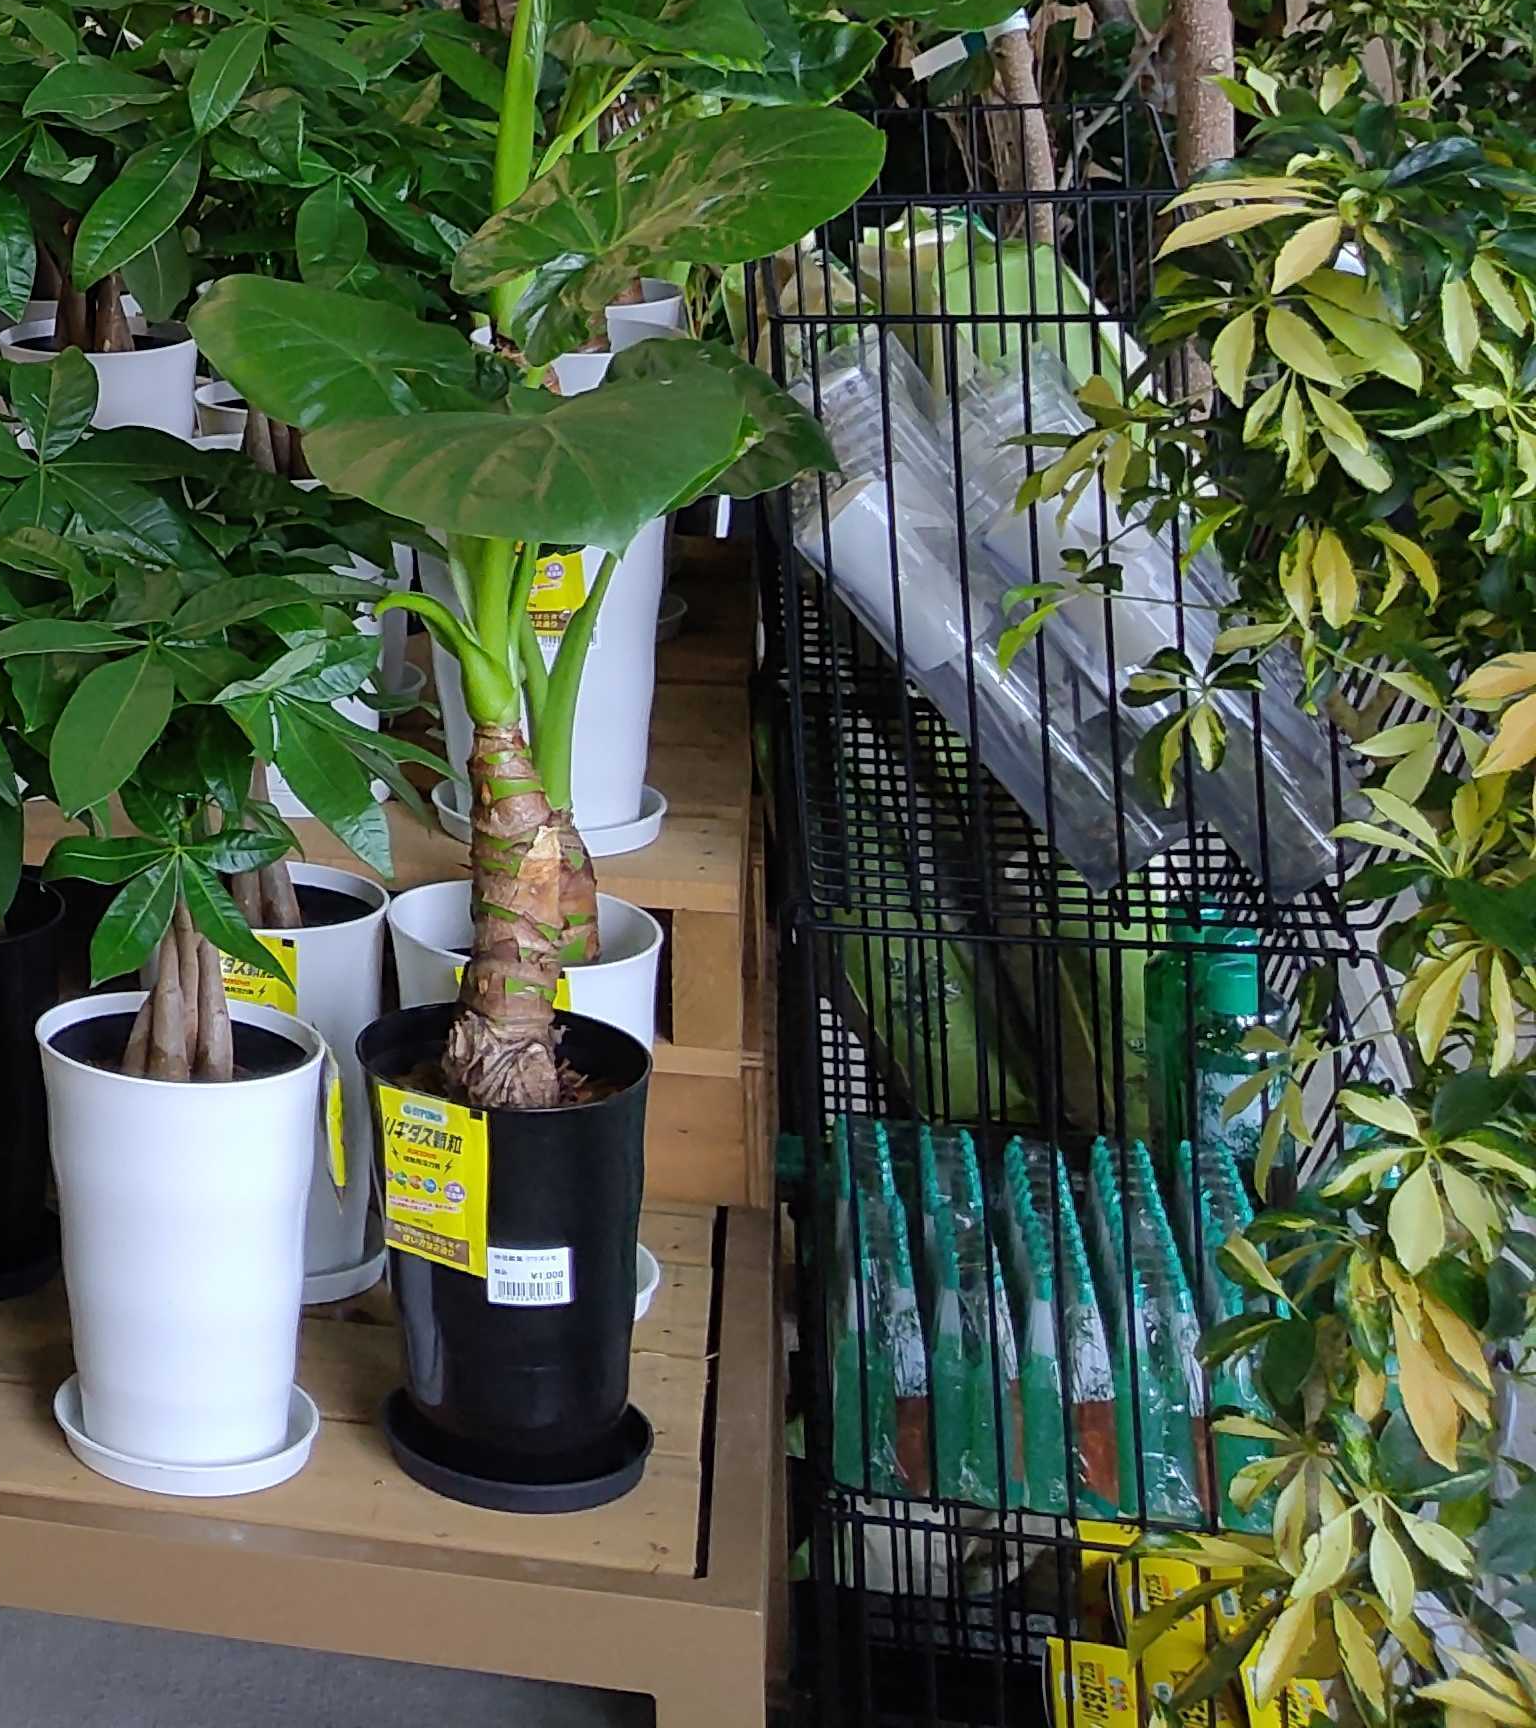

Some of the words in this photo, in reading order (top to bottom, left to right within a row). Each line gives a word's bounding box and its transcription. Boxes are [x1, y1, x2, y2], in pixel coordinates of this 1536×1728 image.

[385, 1115, 463, 1155] リキダス顆粒
